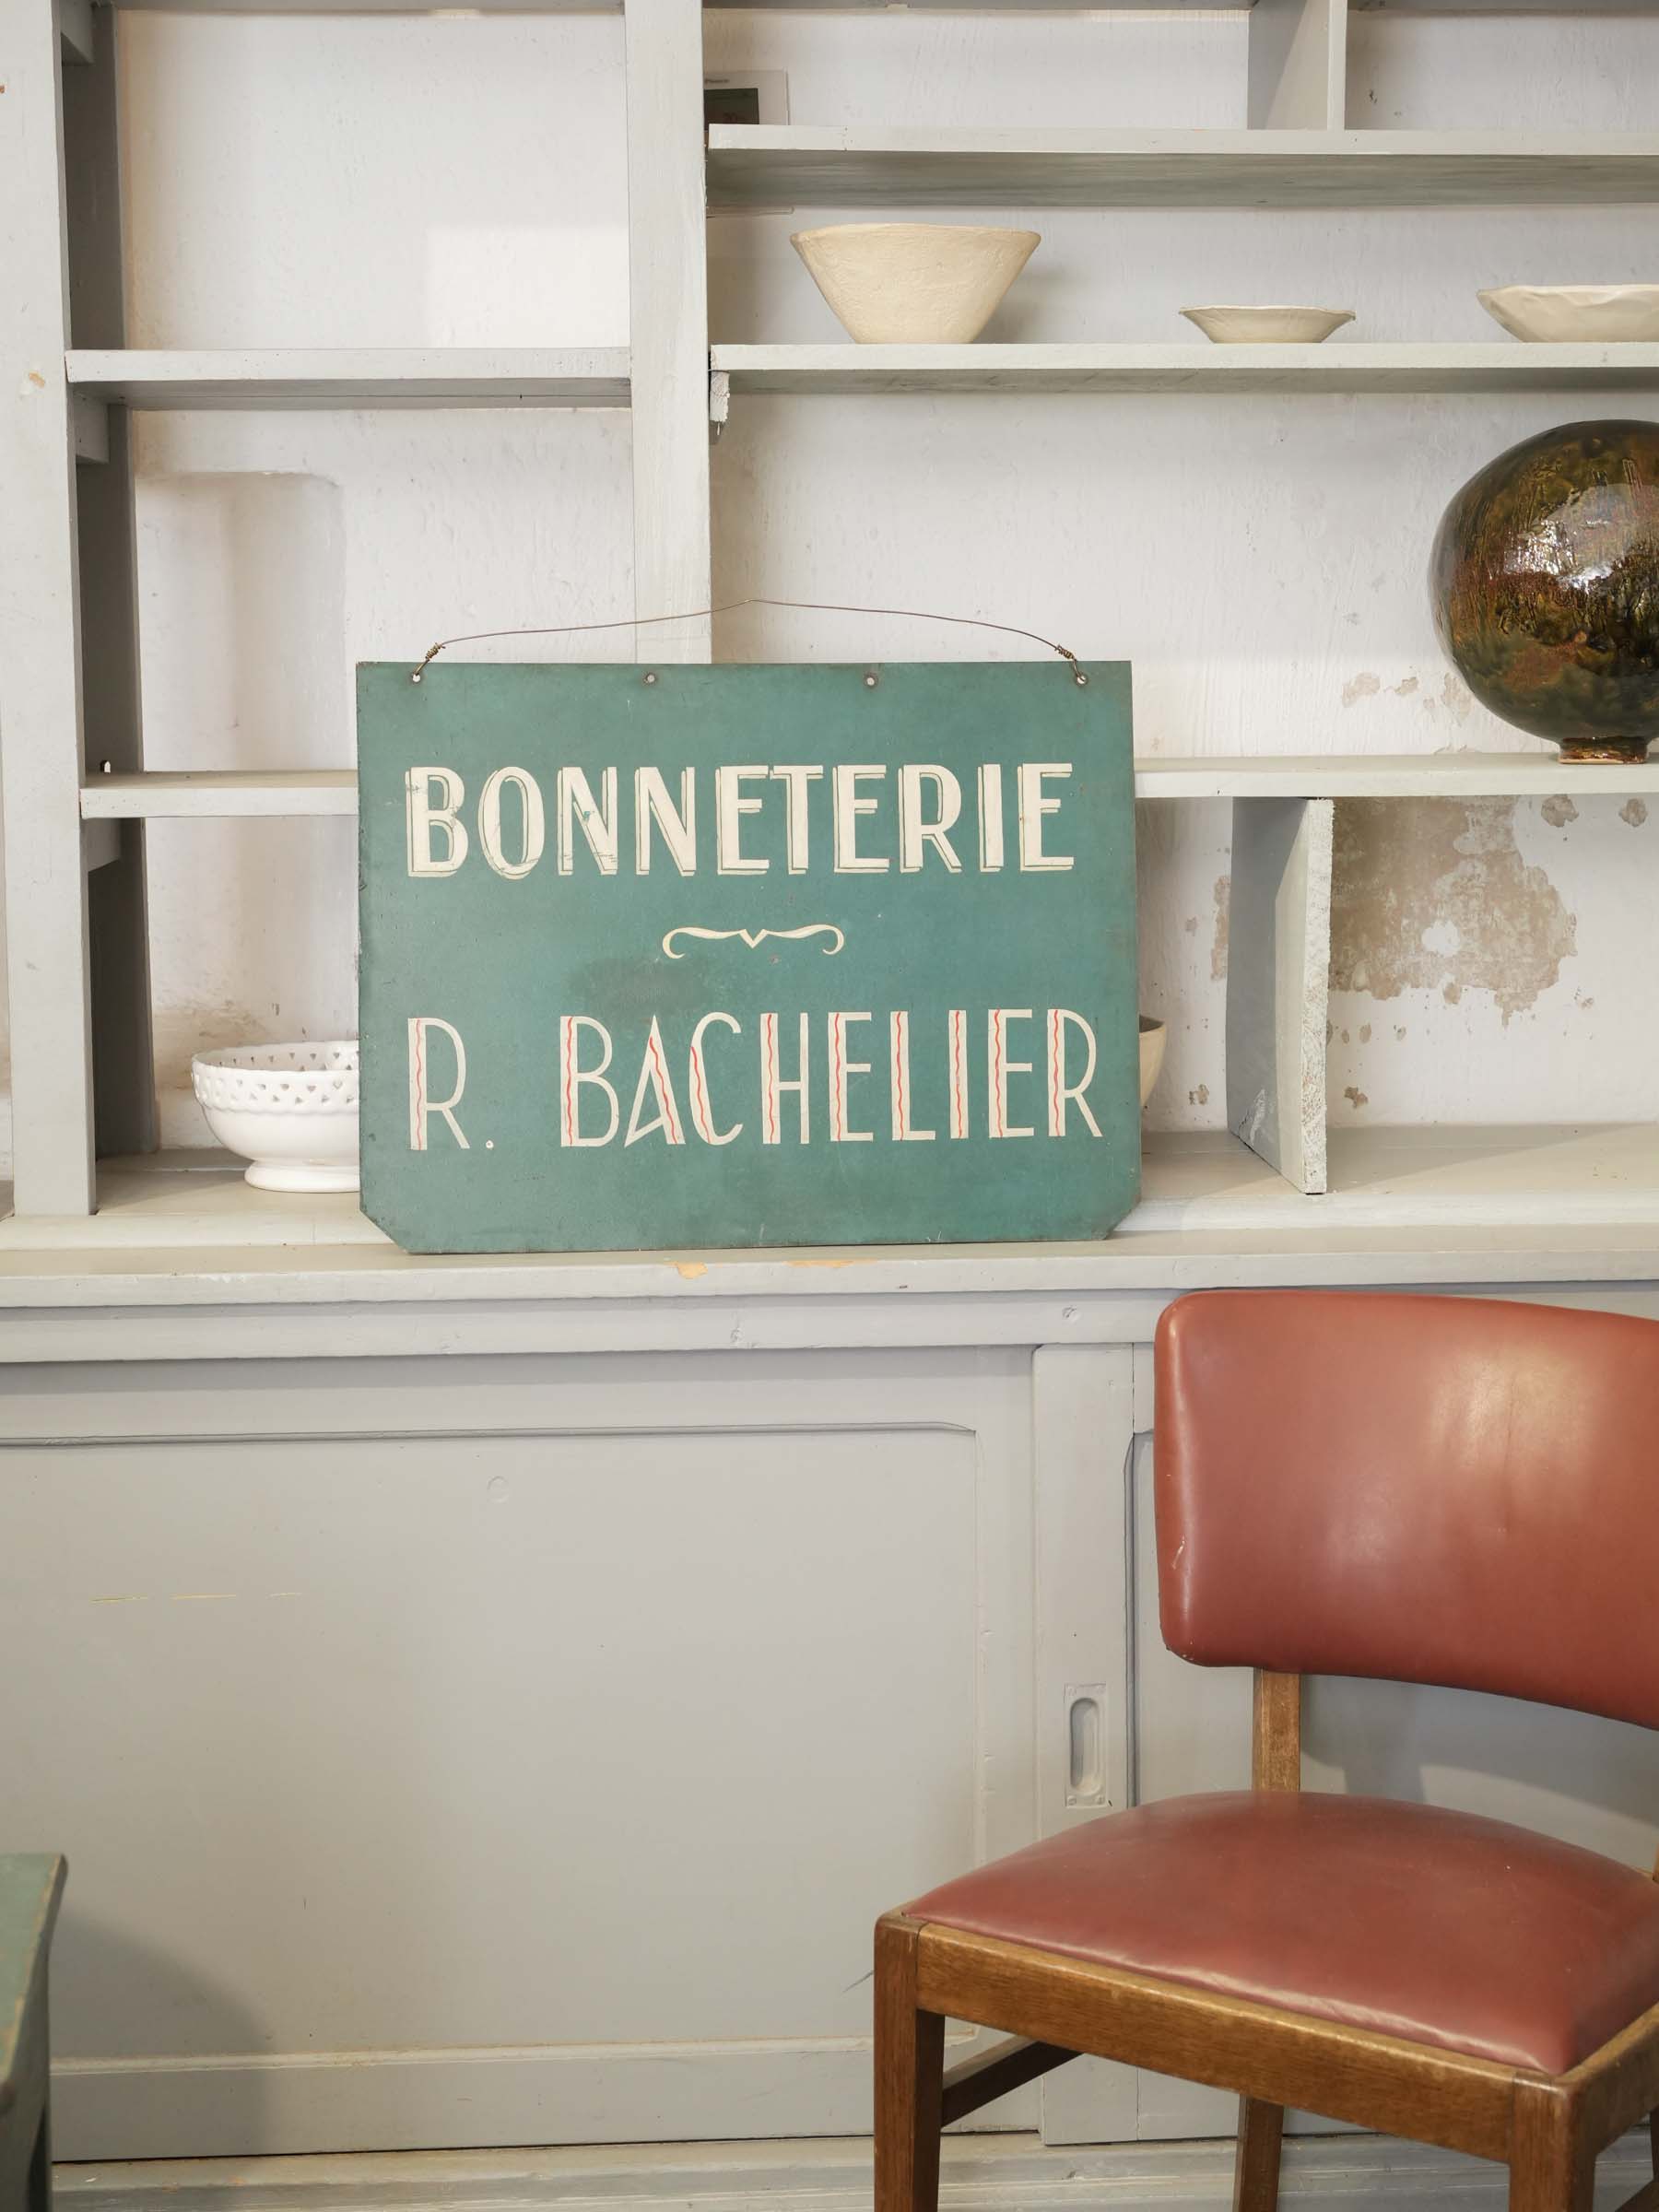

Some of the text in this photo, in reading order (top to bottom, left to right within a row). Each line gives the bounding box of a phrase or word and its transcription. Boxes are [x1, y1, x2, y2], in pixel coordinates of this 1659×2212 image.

[404, 762, 1076, 879] BONNETERIE
[406, 1007, 1103, 1151] R. BACHELIER
